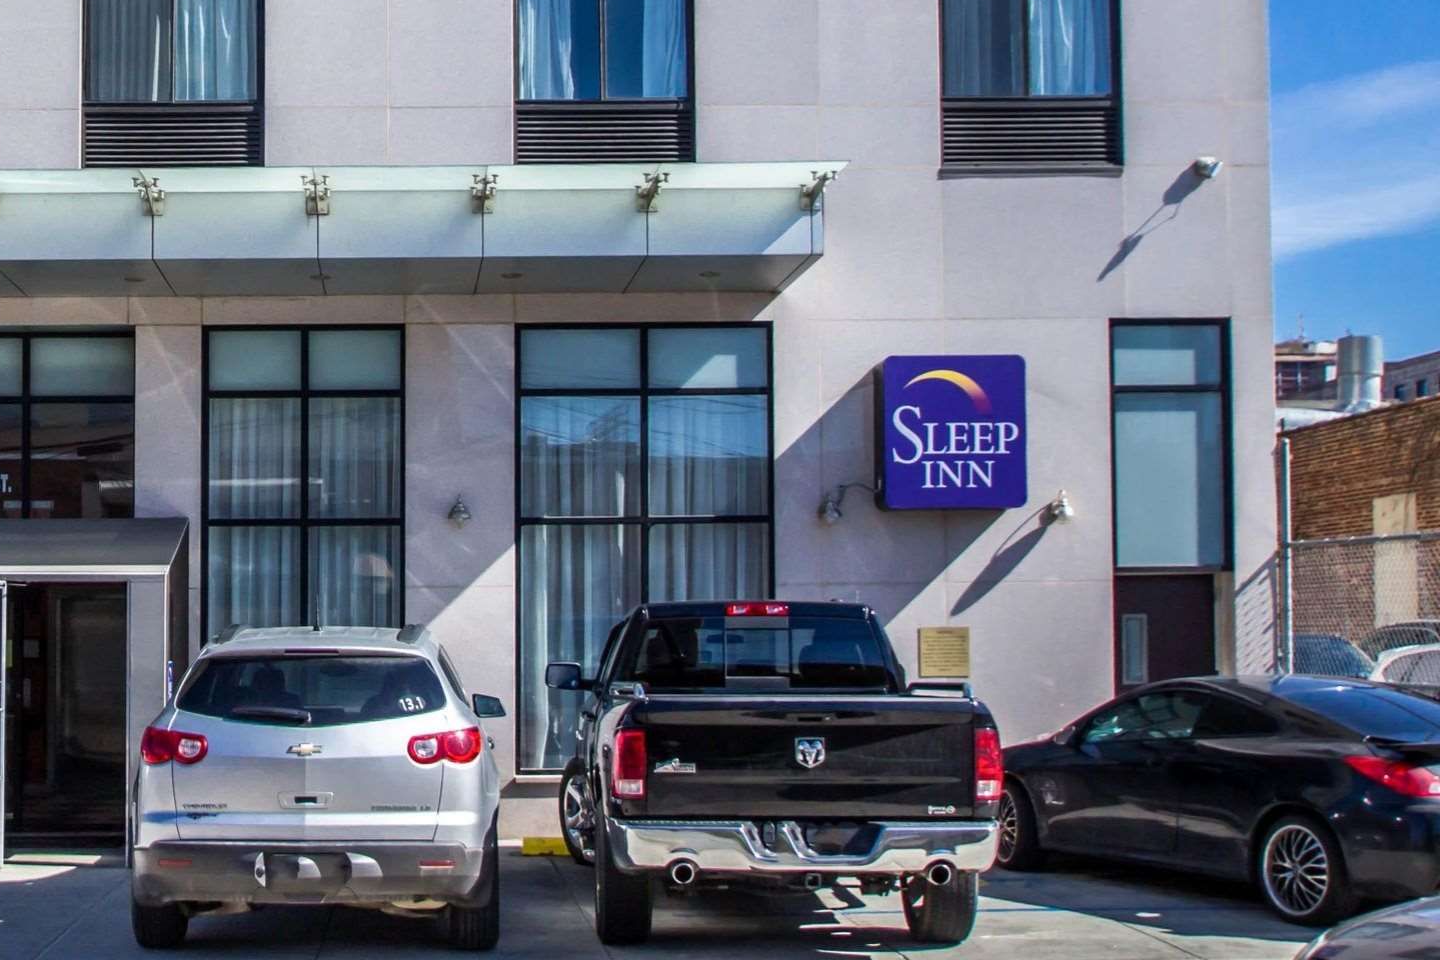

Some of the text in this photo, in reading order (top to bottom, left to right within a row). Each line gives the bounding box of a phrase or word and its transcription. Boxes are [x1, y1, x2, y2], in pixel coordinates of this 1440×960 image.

[892, 405, 1019, 464] SLEEP
[921, 460, 995, 488] INN
[398, 696, 425, 712] 13.1
